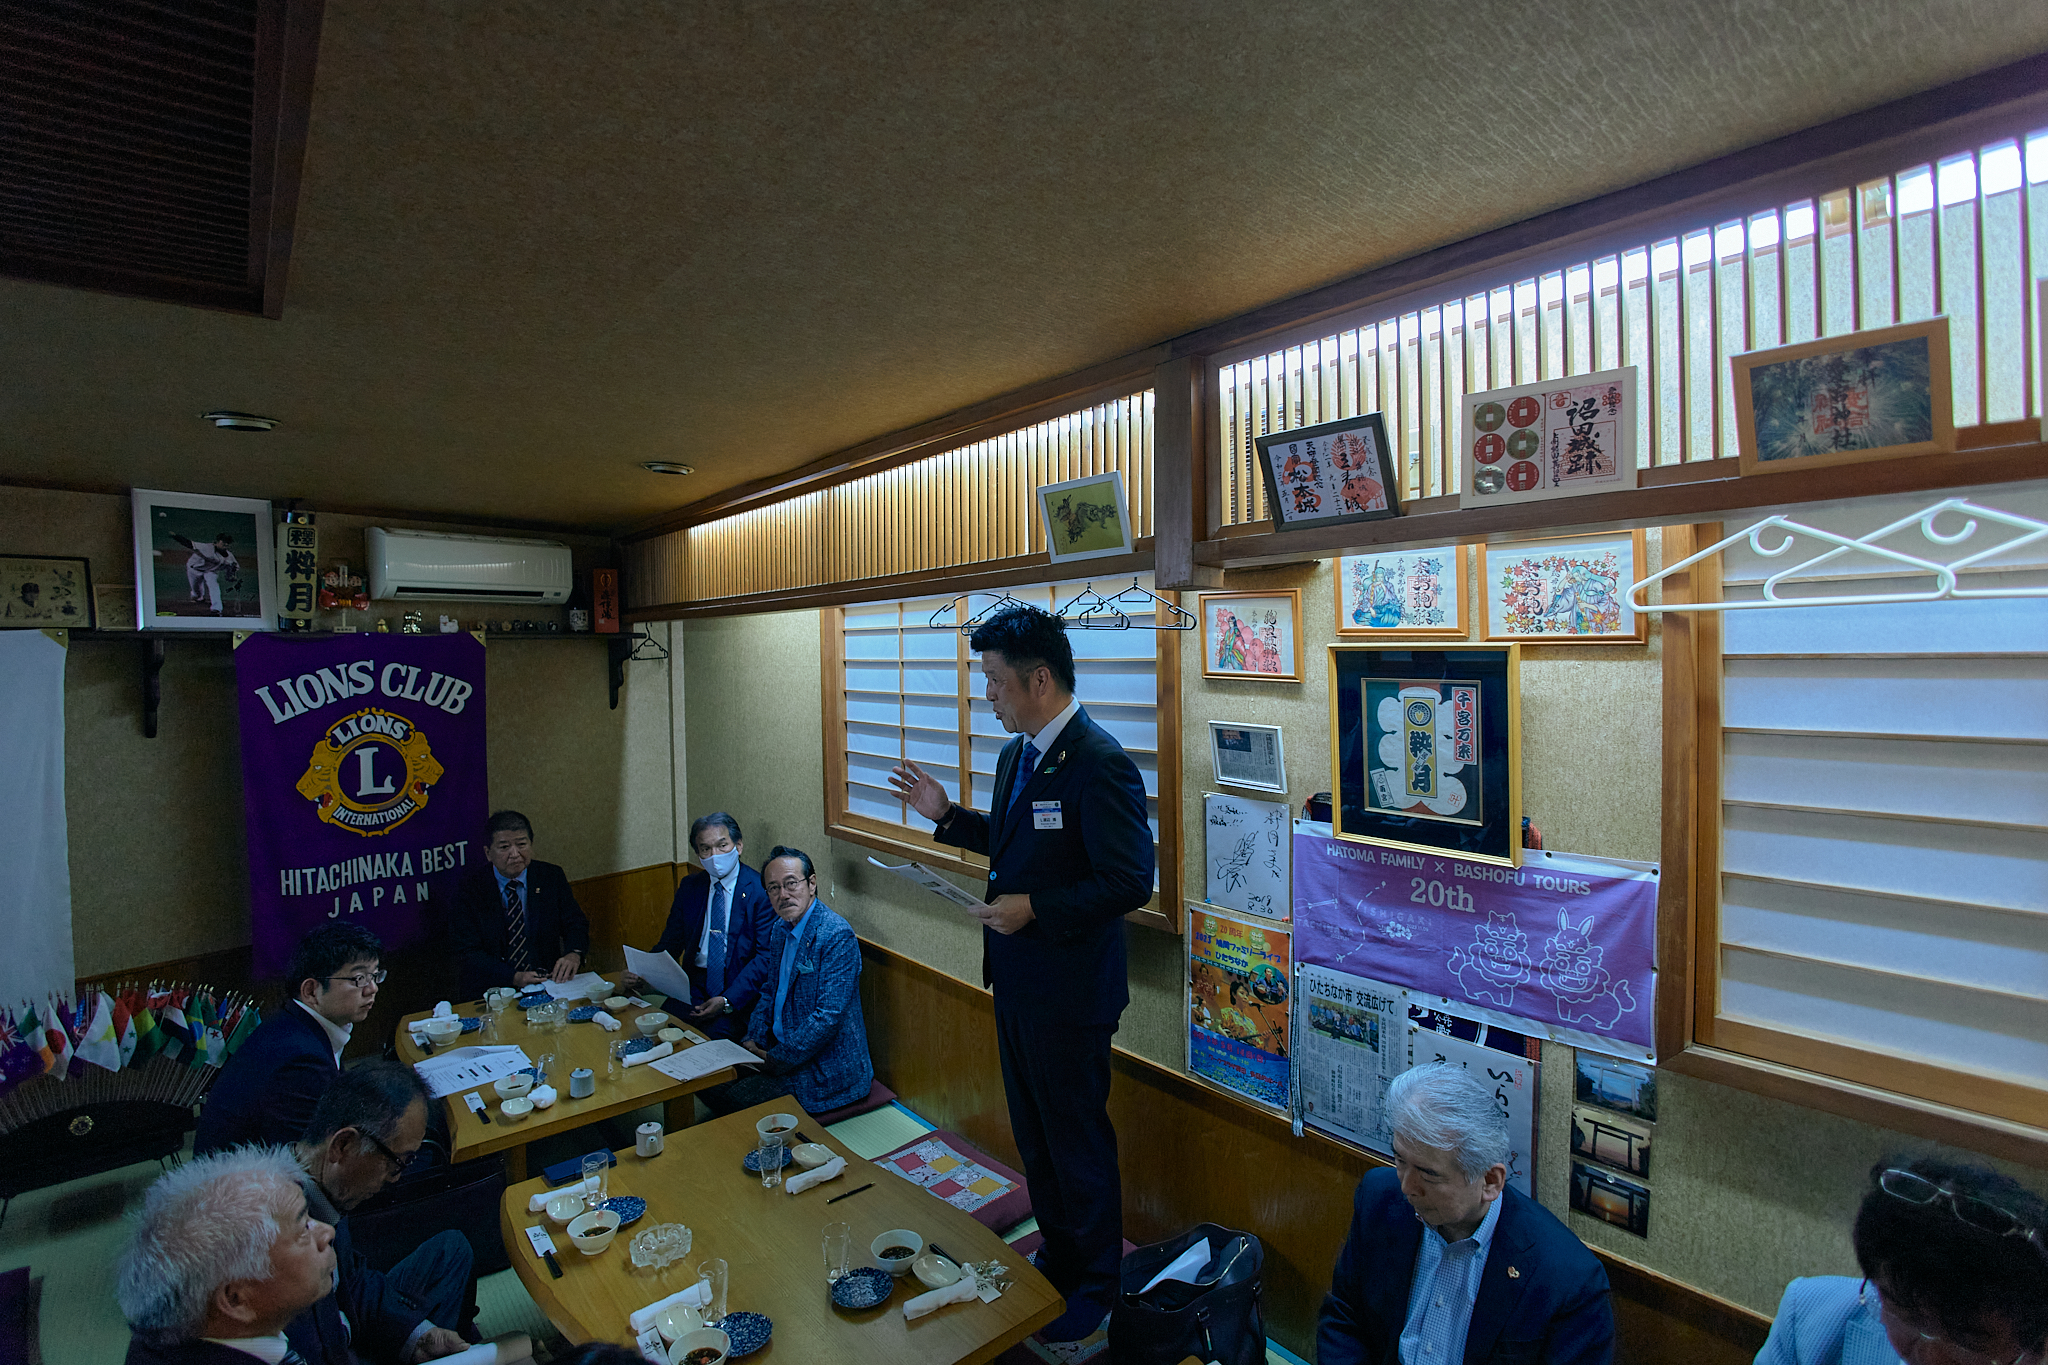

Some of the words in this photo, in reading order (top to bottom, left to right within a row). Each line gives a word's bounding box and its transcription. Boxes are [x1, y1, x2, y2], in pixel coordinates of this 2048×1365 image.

[1288, 467, 1319, 513] 松本城
[254, 659, 375, 725] LIONS
[380, 661, 473, 715] CLUB
[331, 713, 410, 746] LIONS
[1456, 692, 1472, 760] 千客万来
[354, 746, 397, 798] L
[333, 798, 416, 827] INTERNATIONAL
[280, 851, 414, 897] HITACHINAKA
[420, 840, 469, 876] BEST
[1326, 842, 1375, 864] HATOMA
[1380, 852, 1425, 871] FAMILY
[1454, 863, 1525, 887] BASHOFU
[1533, 874, 1592, 896] TOURS
[327, 881, 430, 919] JAPAN
[1247, 901, 1273, 914] 8.30
[1248, 892, 1272, 907] 2019
[1410, 876, 1476, 913] 20th
[1363, 906, 1432, 927] ISHIGAKI
[1195, 931, 1212, 945] 2023
[1204, 947, 1211, 957] in
[1215, 951, 1249, 968] ひたちなか
